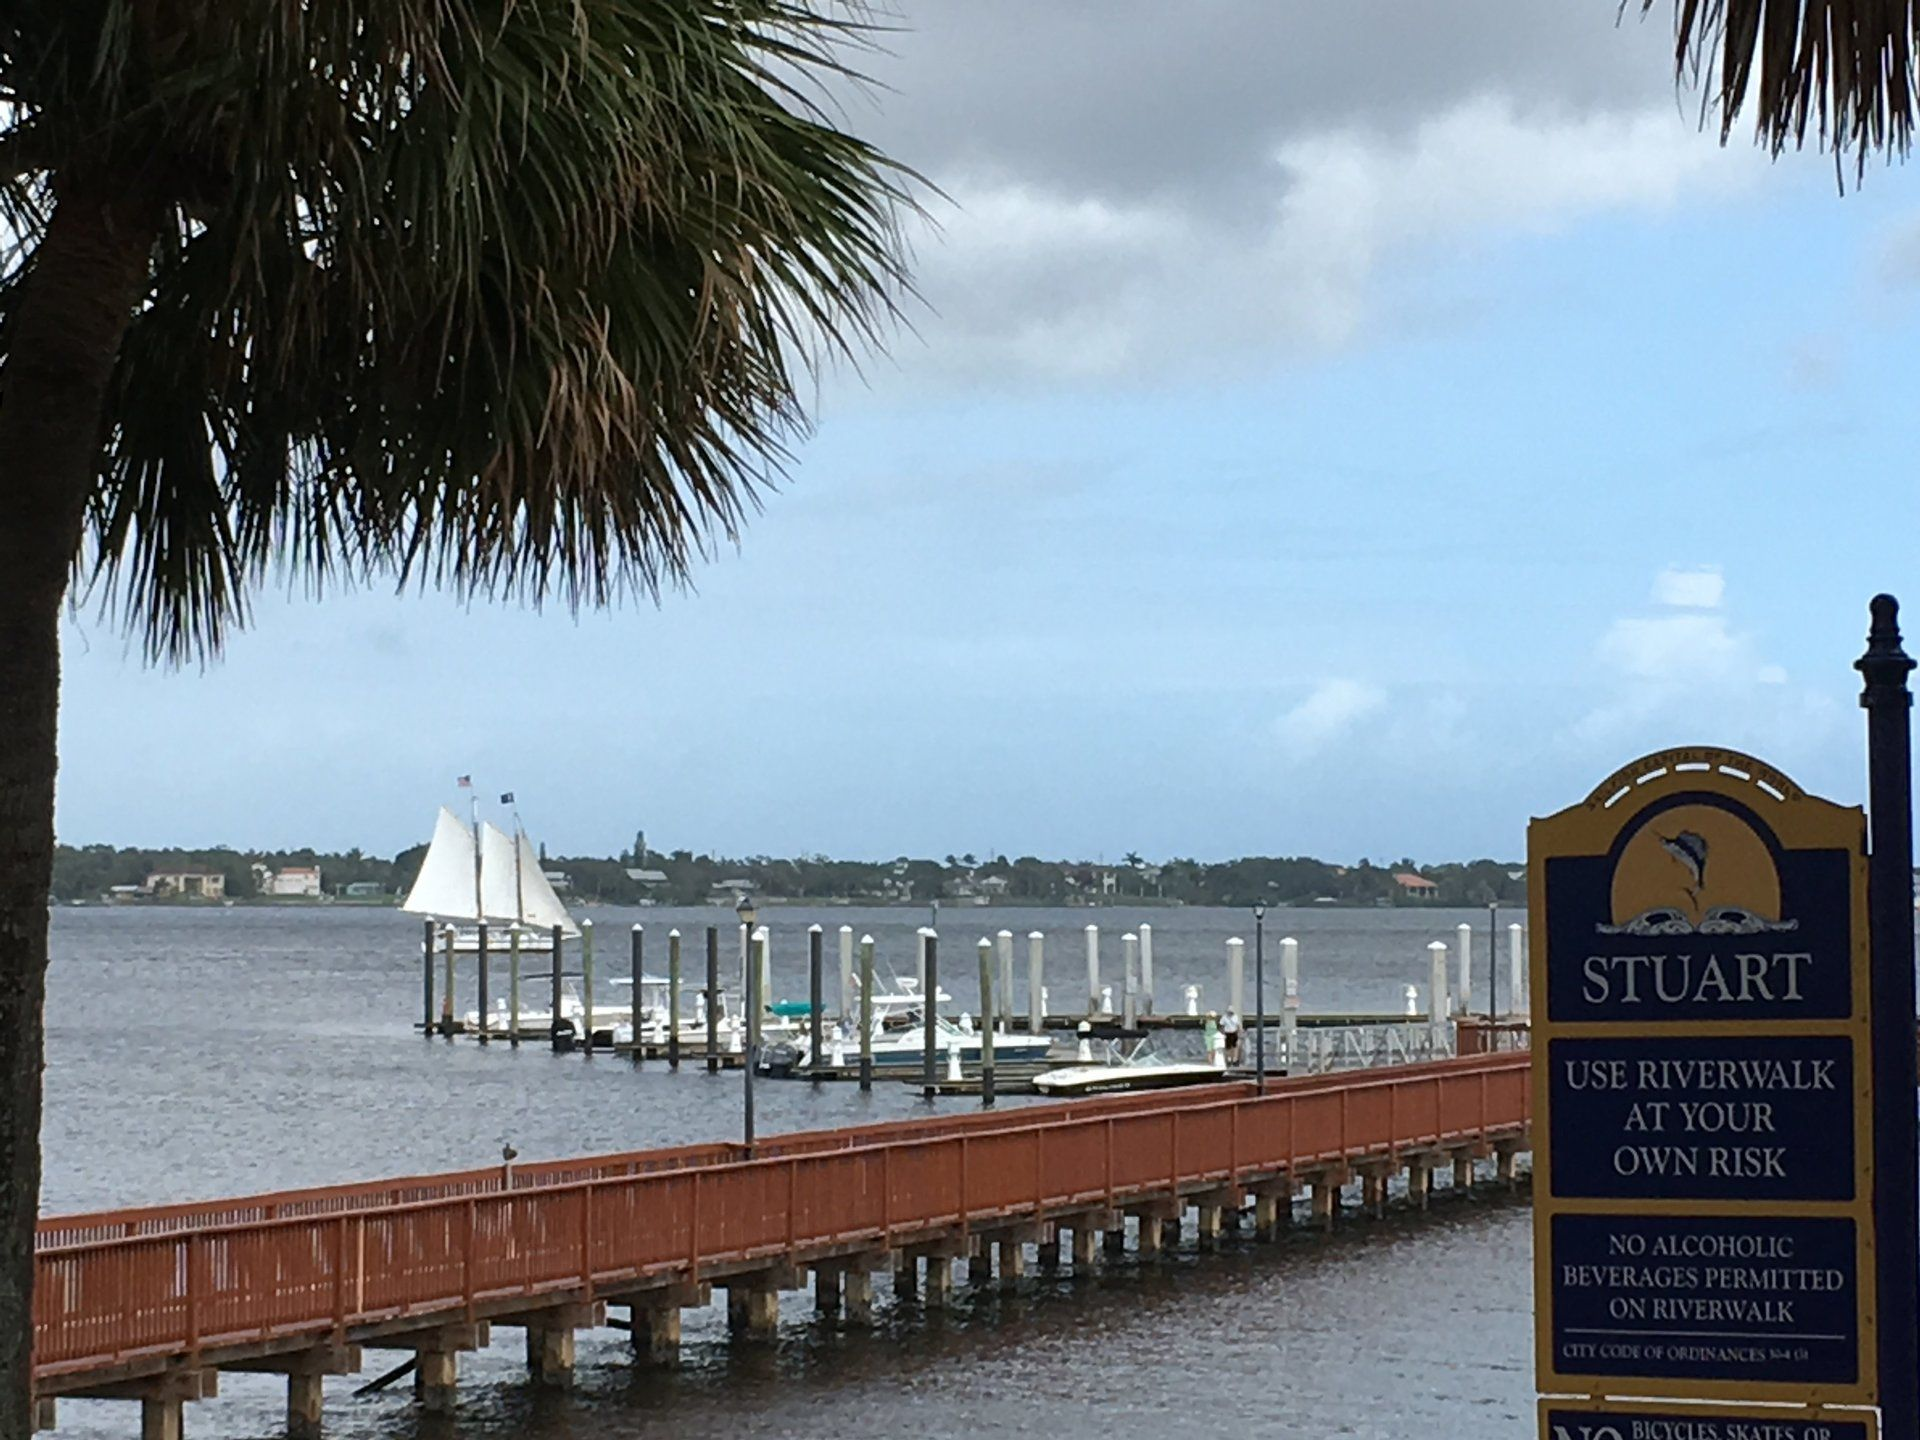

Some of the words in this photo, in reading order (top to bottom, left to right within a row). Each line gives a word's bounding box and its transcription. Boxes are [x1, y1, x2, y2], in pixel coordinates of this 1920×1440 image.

[1583, 953, 1812, 1003] STUART
[1566, 1061, 1627, 1089] USE
[1638, 1060, 1834, 1089] RIVERWALK
[1624, 1102, 1670, 1131] AT
[1679, 1102, 1775, 1132] YOUR
[1614, 1146, 1698, 1175] OWN
[1709, 1147, 1786, 1177] RISK
[1610, 1235, 1645, 1255] NO
[1653, 1235, 1792, 1257] ALCOHOLIC
[1563, 1265, 1698, 1288] BEVERAGES
[1705, 1268, 1843, 1290] PERMITTED
[1610, 1298, 1645, 1318] ON
[1653, 1299, 1793, 1322] RIVERWALK
[1563, 1344, 1595, 1357] CITY
[1600, 1344, 1640, 1358] CODE
[1644, 1346, 1663, 1359] OF
[1667, 1346, 1765, 1362] ORDINANCES
[1632, 1421, 1722, 1440] BICYCLES,
[1804, 1427, 1830, 1440] OR
